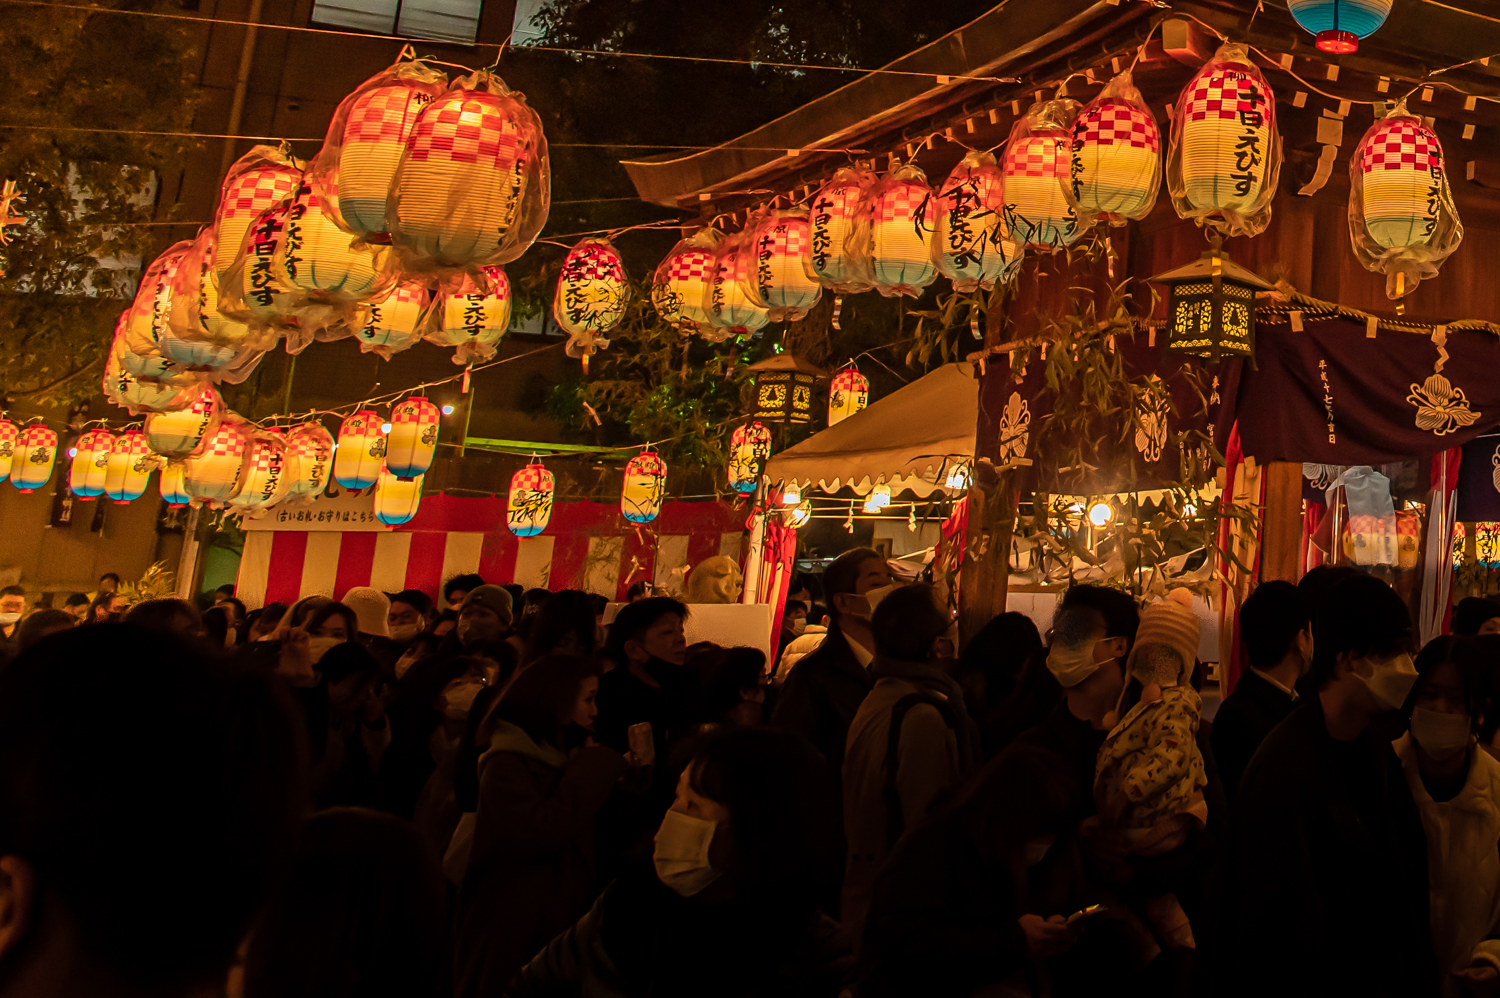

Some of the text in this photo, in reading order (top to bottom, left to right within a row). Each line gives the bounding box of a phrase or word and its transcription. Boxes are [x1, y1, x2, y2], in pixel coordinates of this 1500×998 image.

[1229, 85, 1265, 197] 十日えびす
[250, 219, 284, 305] 十日えびす
[813, 197, 834, 270] 十日えびす
[948, 187, 975, 270] 十日えびす
[711, 263, 728, 318] 十日えびす
[758, 236, 775, 300] 十日えびす
[260, 453, 283, 501] 十日えびす
[308, 445, 328, 488] 十日えびす
